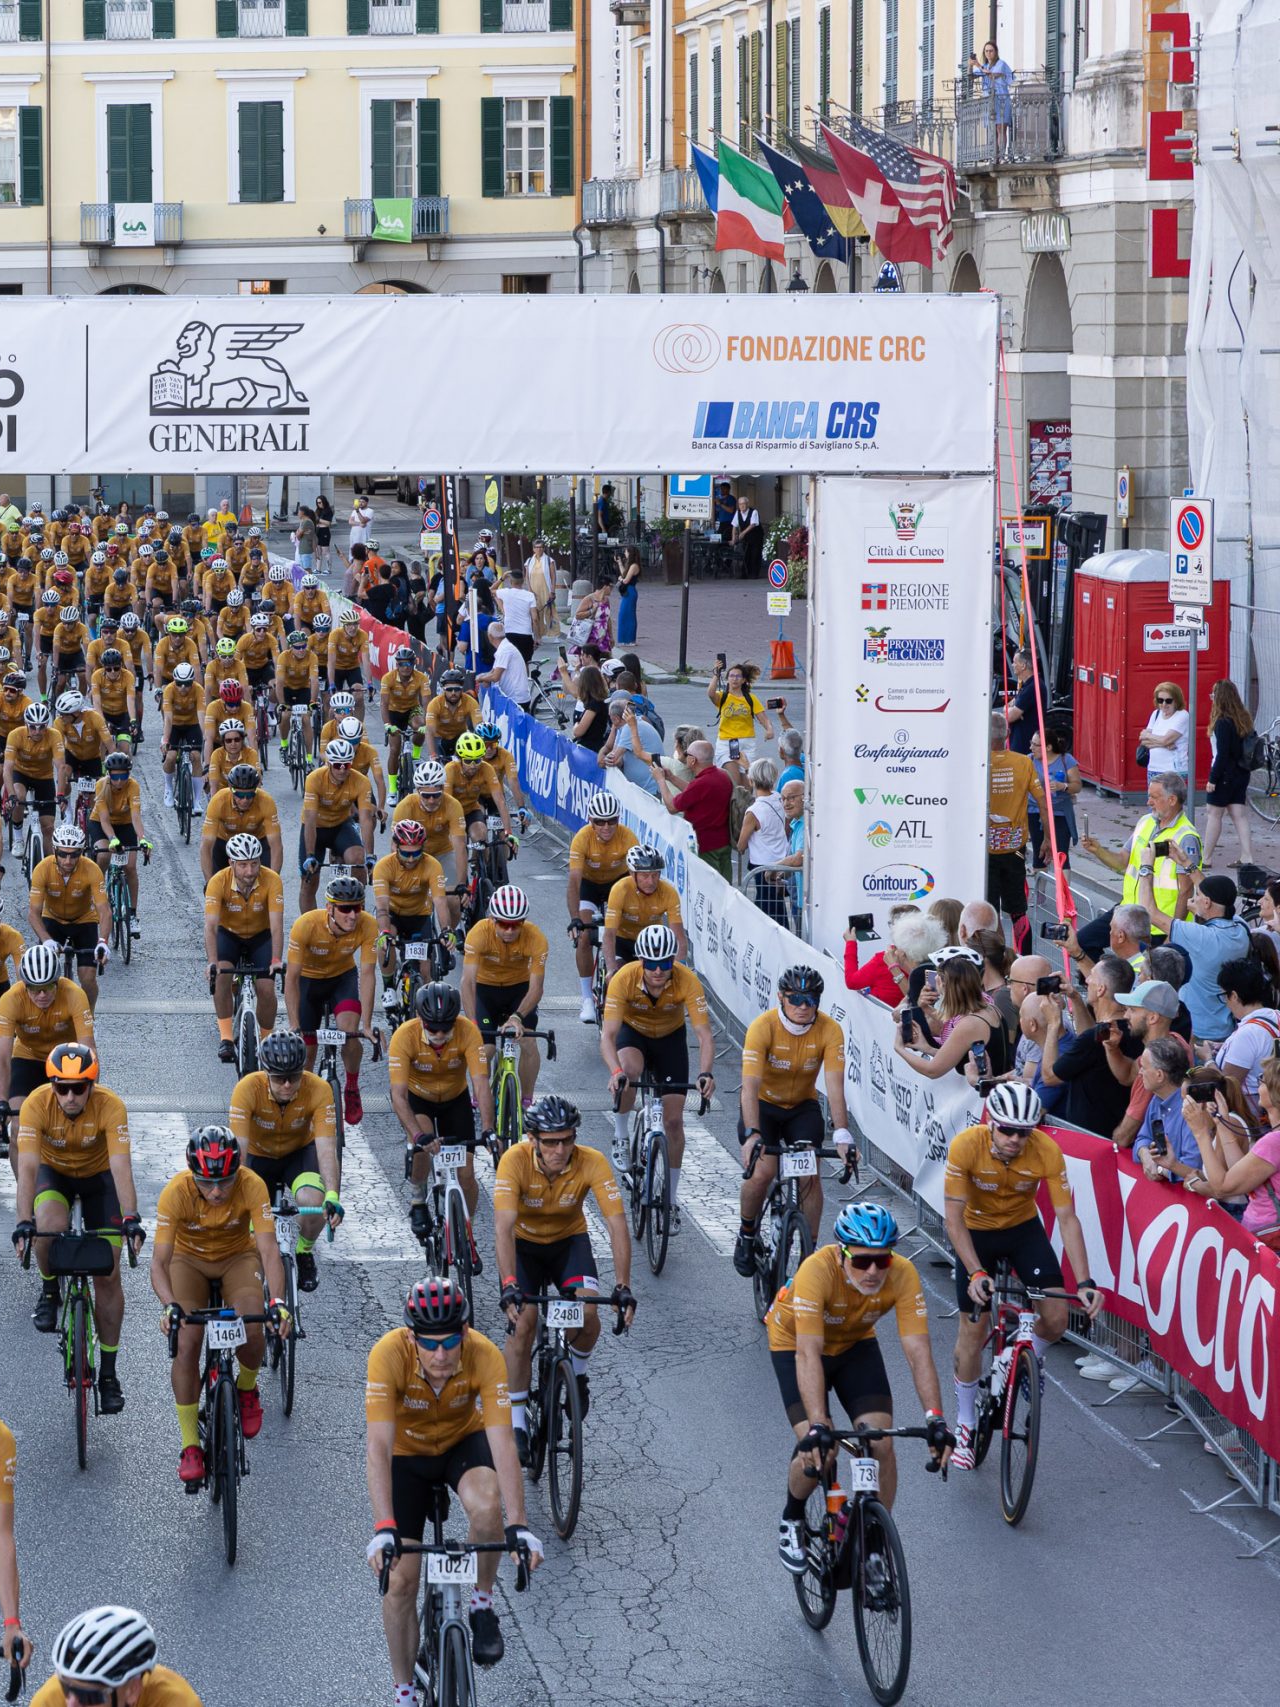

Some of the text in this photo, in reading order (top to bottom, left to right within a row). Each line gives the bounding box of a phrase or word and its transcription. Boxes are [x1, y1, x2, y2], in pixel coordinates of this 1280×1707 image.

[1021, 214, 1068, 249] FARMACIA
[727, 336, 926, 361] FONDAZIONE CRC
[732, 401, 880, 439] BANCA CRS
[149, 423, 310, 452] GENERALI
[692, 441, 880, 451] Banca Cassa di Risparmio di Savigliano S.p.A.
[868, 545, 944, 557] Città di Cuneo
[890, 584, 949, 597] REGIONE
[889, 599, 949, 610] PIEMONTE
[1164, 628, 1206, 638] SEBAH
[889, 640, 944, 649] PROVINCIA
[889, 650, 944, 660] di CUNEO
[854, 743, 949, 763] Confartigianato
[881, 794, 948, 806] WeCuneo
[895, 821, 933, 838] ATL
[863, 874, 918, 891] Cônitours
[440, 1152, 461, 1163] 1971
[792, 1158, 809, 1170] 702
[553, 1308, 578, 1321] 2480
[214, 1328, 240, 1342] 1464
[436, 1559, 469, 1574] 1027
